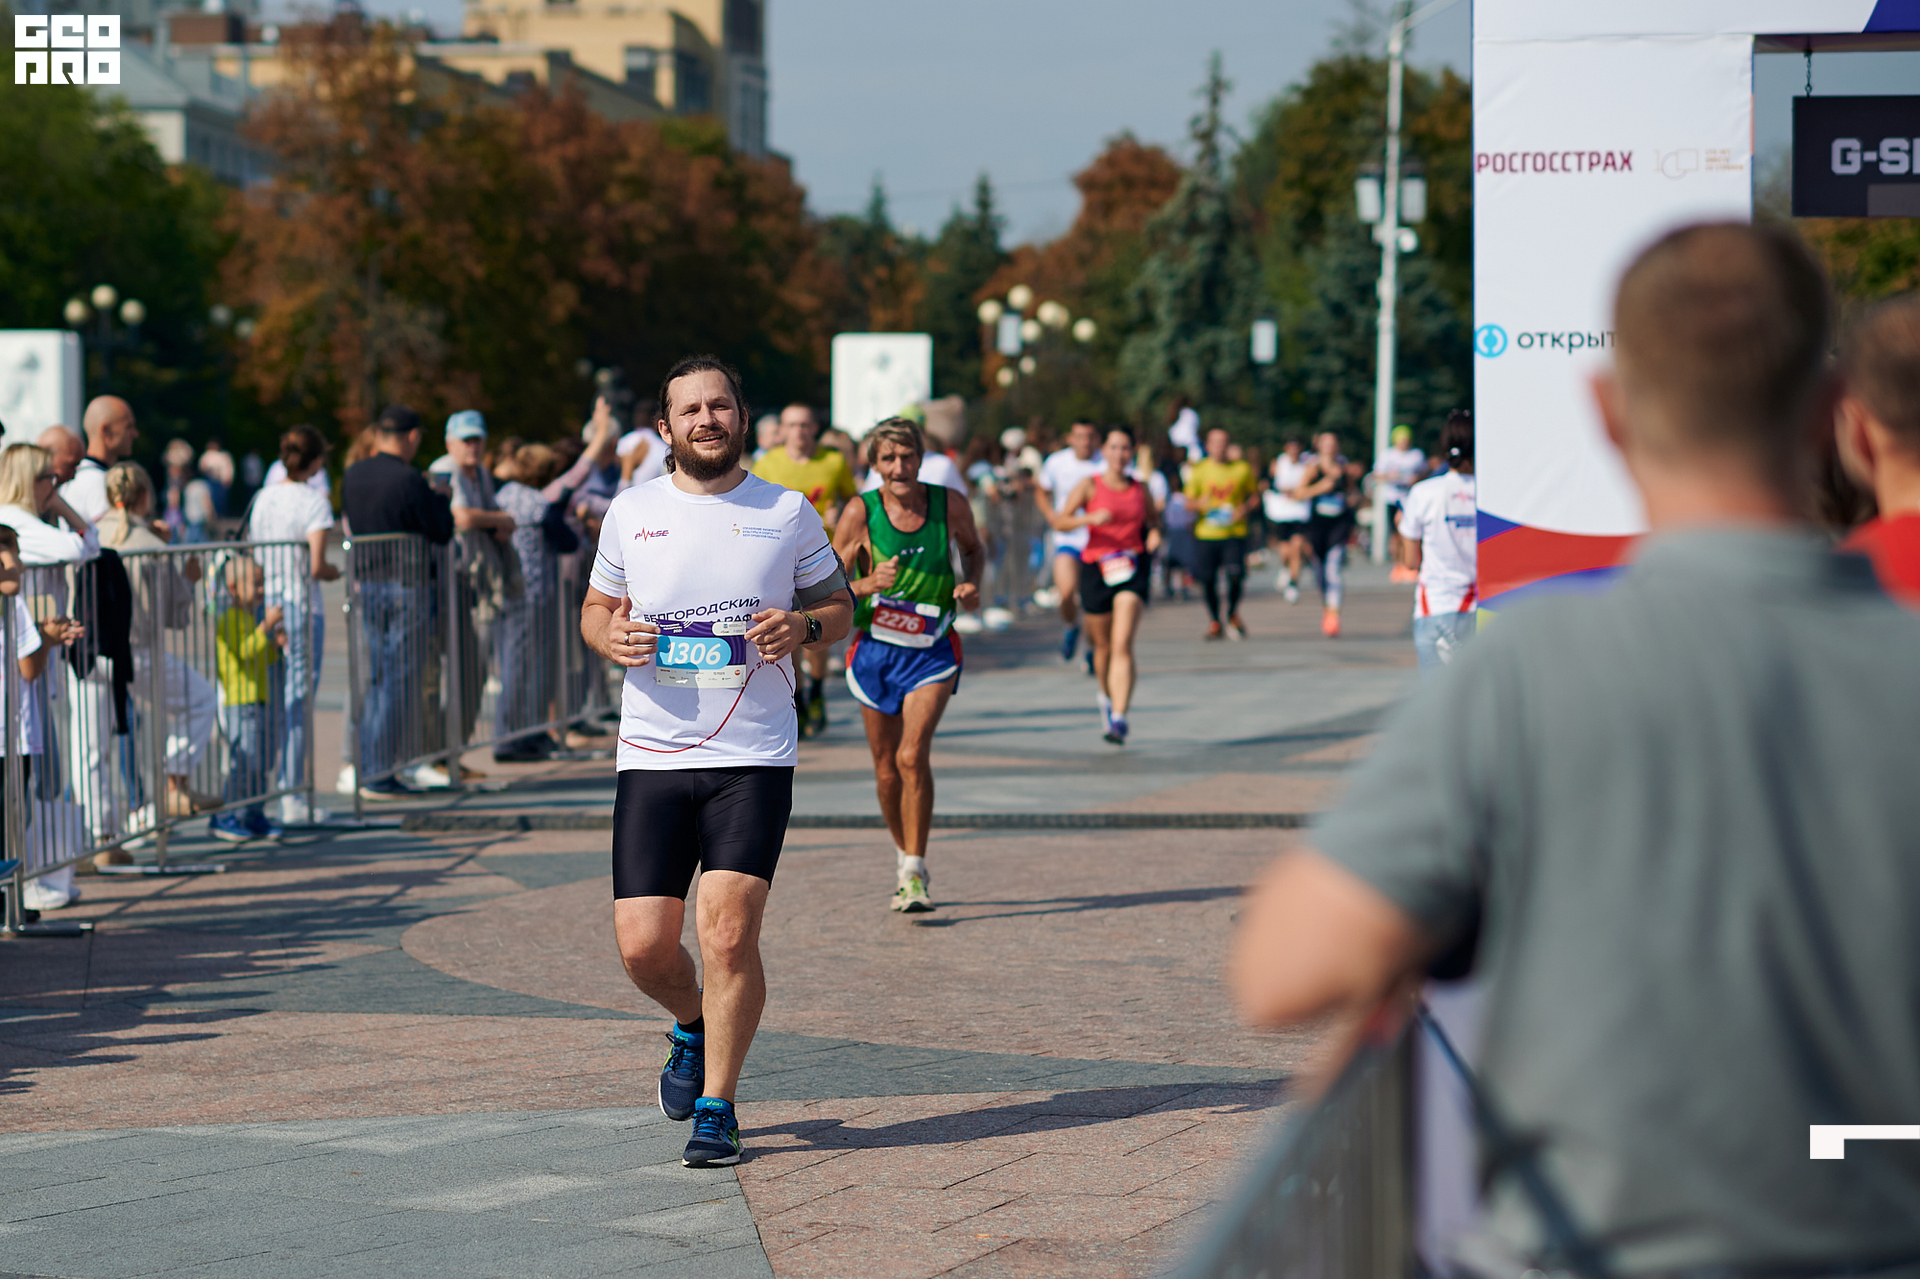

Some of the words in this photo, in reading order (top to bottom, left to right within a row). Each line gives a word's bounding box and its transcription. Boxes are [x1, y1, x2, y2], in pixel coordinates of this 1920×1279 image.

[1476, 150, 1633, 173] РОСГОССТРАХ
[1831, 137, 1920, 175] G-S
[643, 596, 760, 623] БЕЛГОРОДСКИЙ
[876, 609, 920, 632] 2276
[667, 641, 721, 665] 1306
